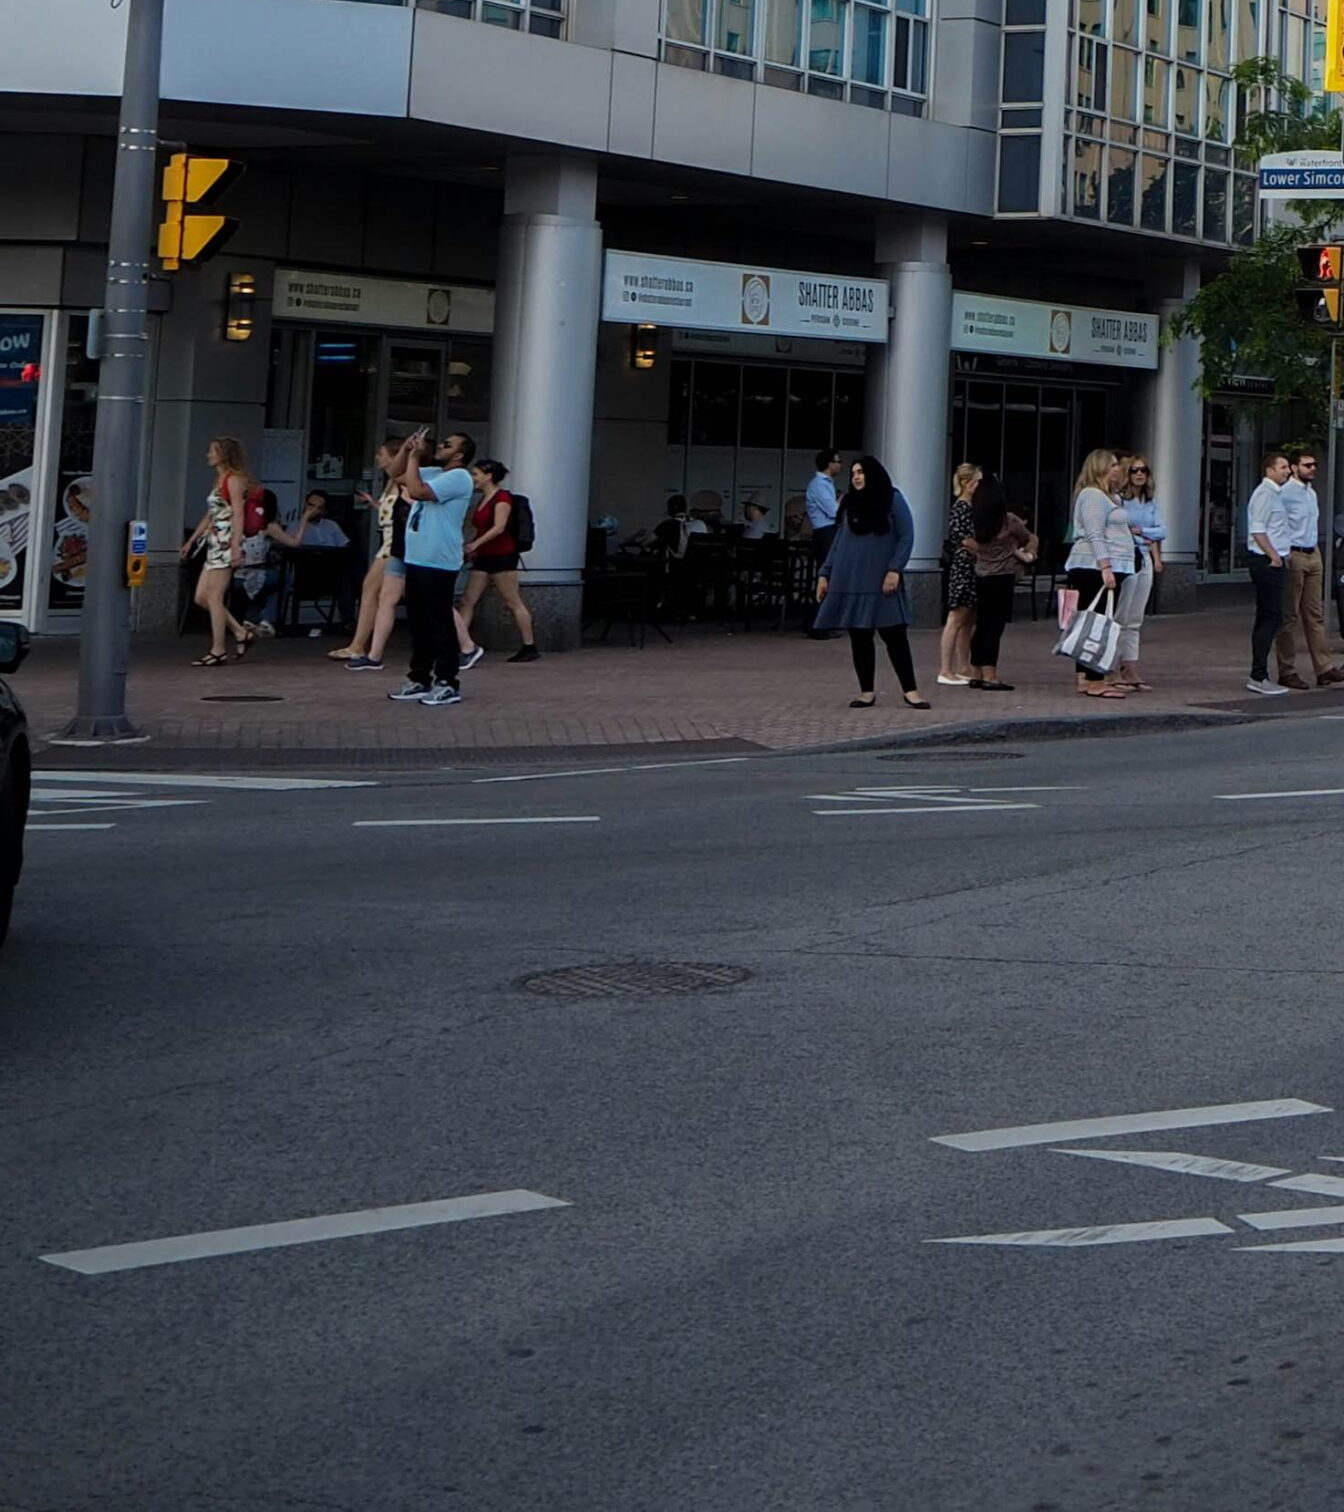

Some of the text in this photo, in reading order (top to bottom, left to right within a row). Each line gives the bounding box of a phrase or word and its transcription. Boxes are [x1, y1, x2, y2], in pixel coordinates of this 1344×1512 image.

[1263, 171, 1300, 186] Lower
[798, 281, 874, 314] SHATTER ABBAS
[1091, 317, 1148, 343] SHATTER ABBAS
